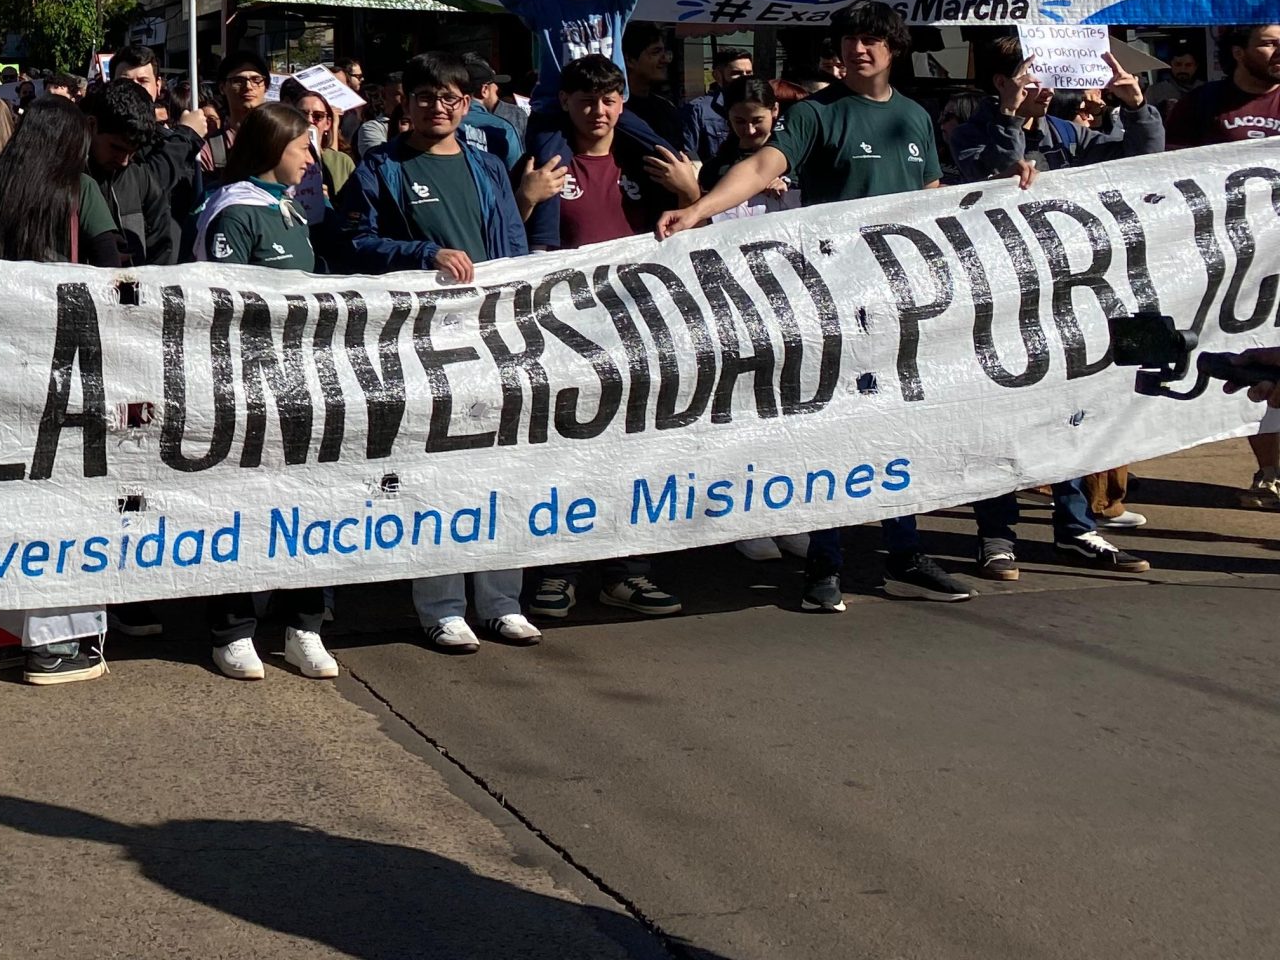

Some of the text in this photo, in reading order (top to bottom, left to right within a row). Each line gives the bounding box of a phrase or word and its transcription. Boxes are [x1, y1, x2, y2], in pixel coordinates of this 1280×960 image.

[1019, 26, 1045, 39] LOS
[1224, 115, 1280, 132] LACOST
[159, 241, 842, 473] UNIVERSIDAD
[860, 165, 1280, 402] PÚBLIC
[268, 491, 498, 560] Nacional
[528, 487, 597, 538] de
[630, 456, 913, 525] Misiones
